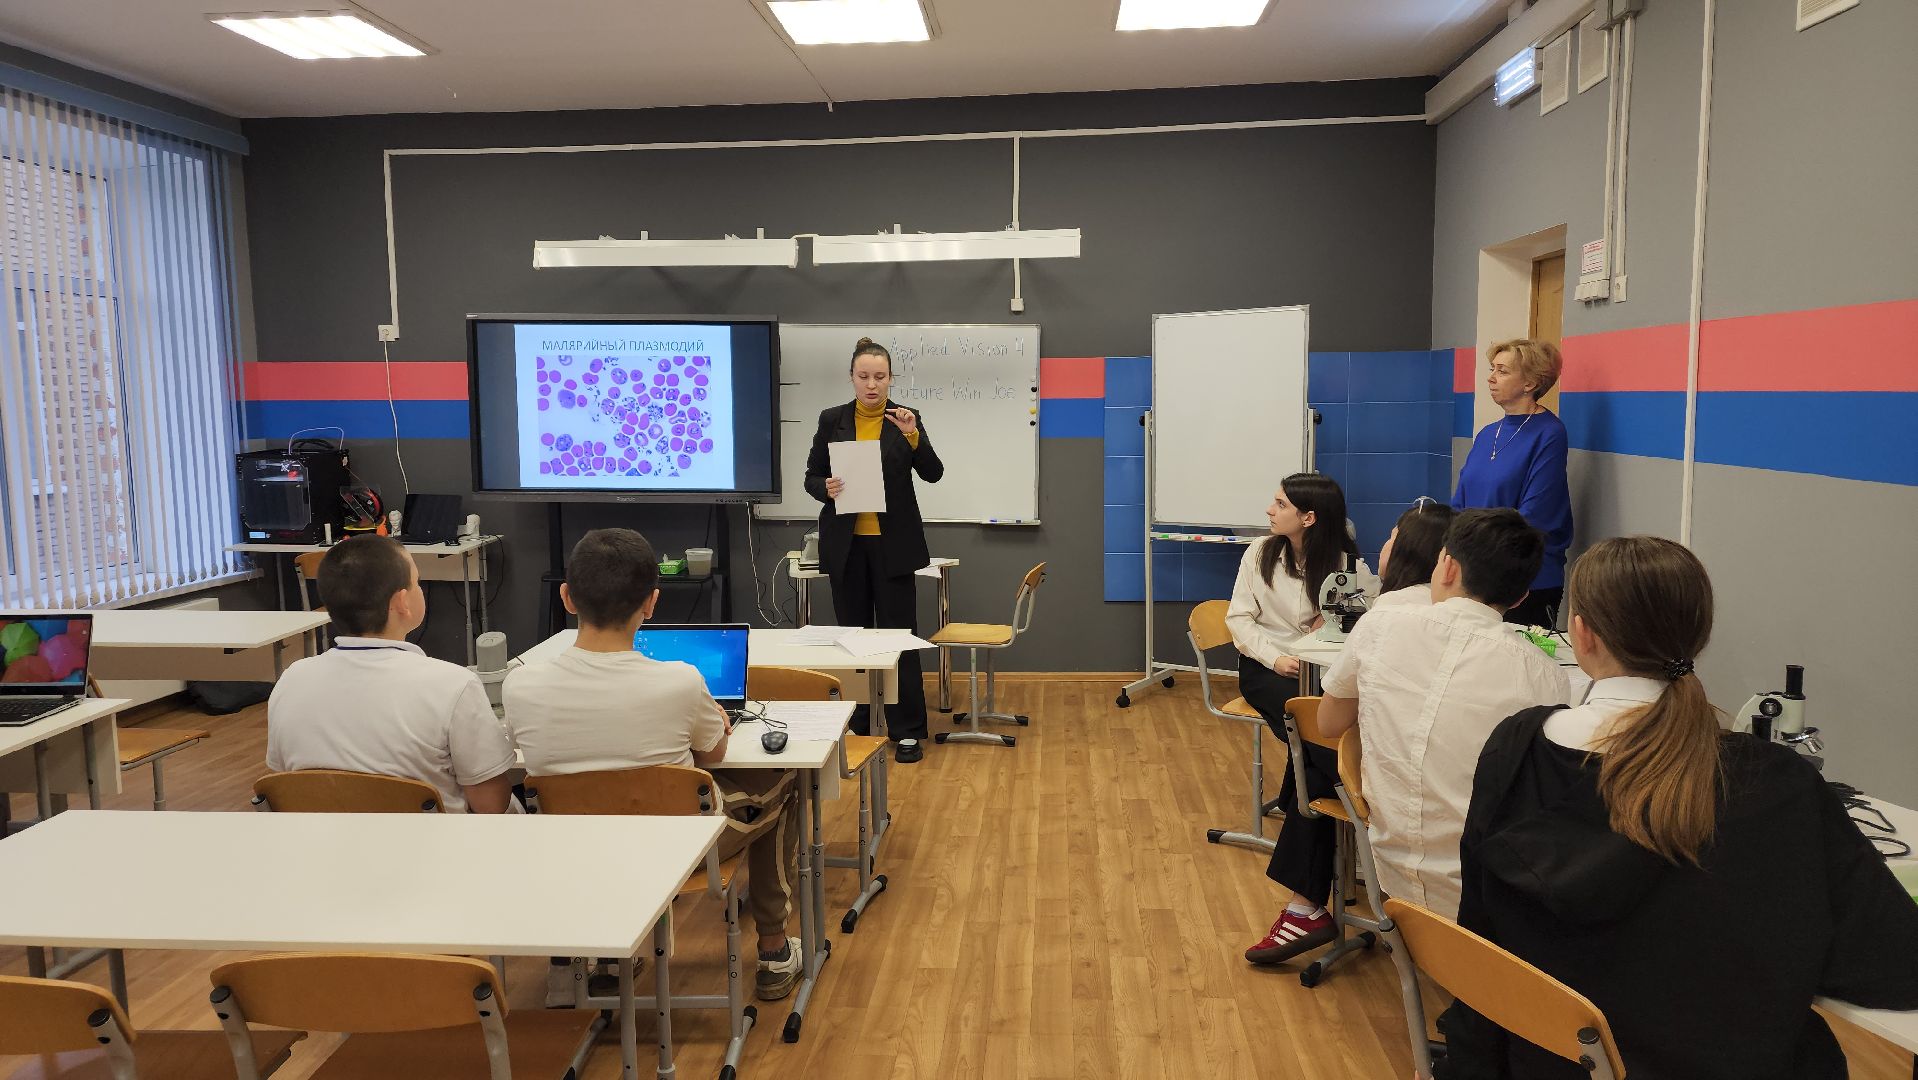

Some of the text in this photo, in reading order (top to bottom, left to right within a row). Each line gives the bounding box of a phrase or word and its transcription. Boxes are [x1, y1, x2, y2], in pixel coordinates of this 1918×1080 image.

[542, 339, 705, 353] МАЛЯРИЙНЫЙ ПЛАЗМОДИЙ
[890, 335, 952, 372] Applied
[958, 336, 1008, 357] Vision
[889, 374, 945, 401] Future
